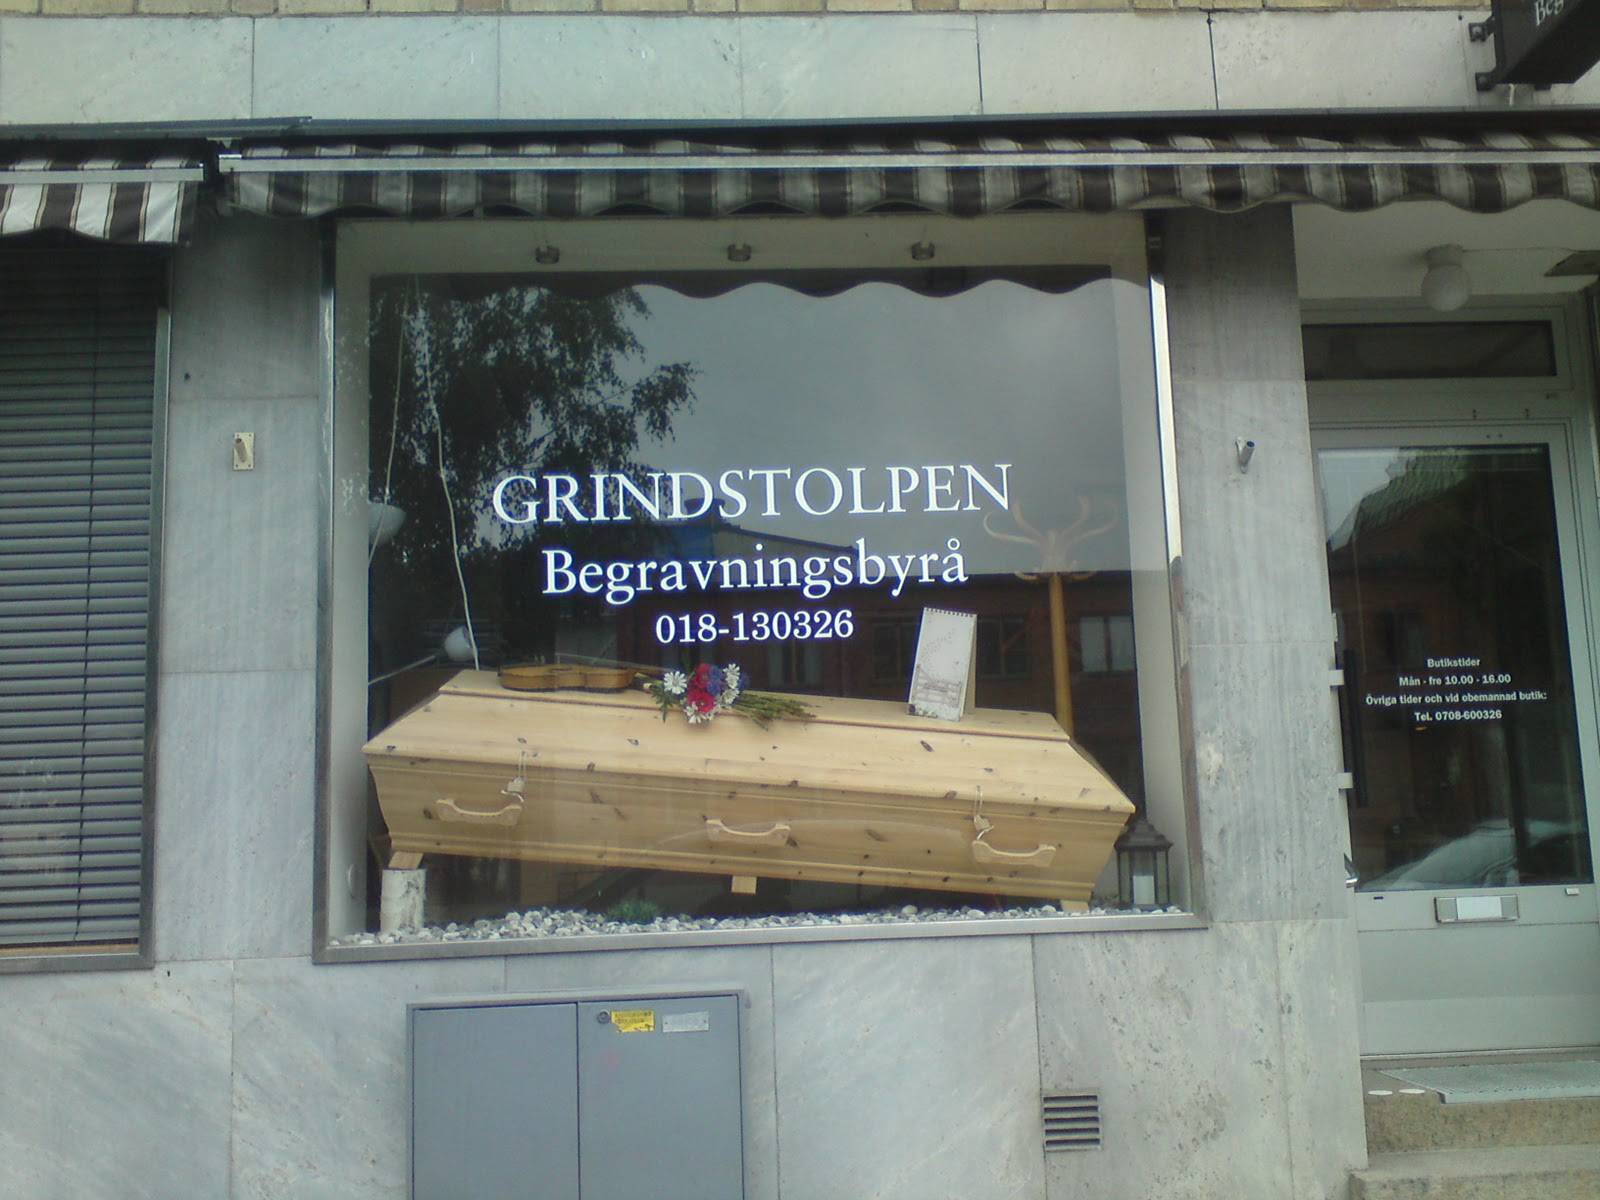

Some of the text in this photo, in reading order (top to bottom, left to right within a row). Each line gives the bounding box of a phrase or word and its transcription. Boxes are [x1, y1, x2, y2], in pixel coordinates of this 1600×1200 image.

[492, 463, 1012, 525] GRINDSTOLPEN
[541, 537, 969, 606] Begravningsbyrå
[655, 609, 855, 645] 018-130326
[1426, 657, 1481, 669] Butikstider
[1398, 675, 1422, 687] Mån
[1428, 675, 1443, 686] fre
[1445, 674, 1474, 685] 10.00
[1482, 673, 1512, 684] 16.00
[1365, 690, 1548, 707] Övriga tider och vid obemannad butik:
[1414, 709, 1503, 723] Tel. 0708-600326
